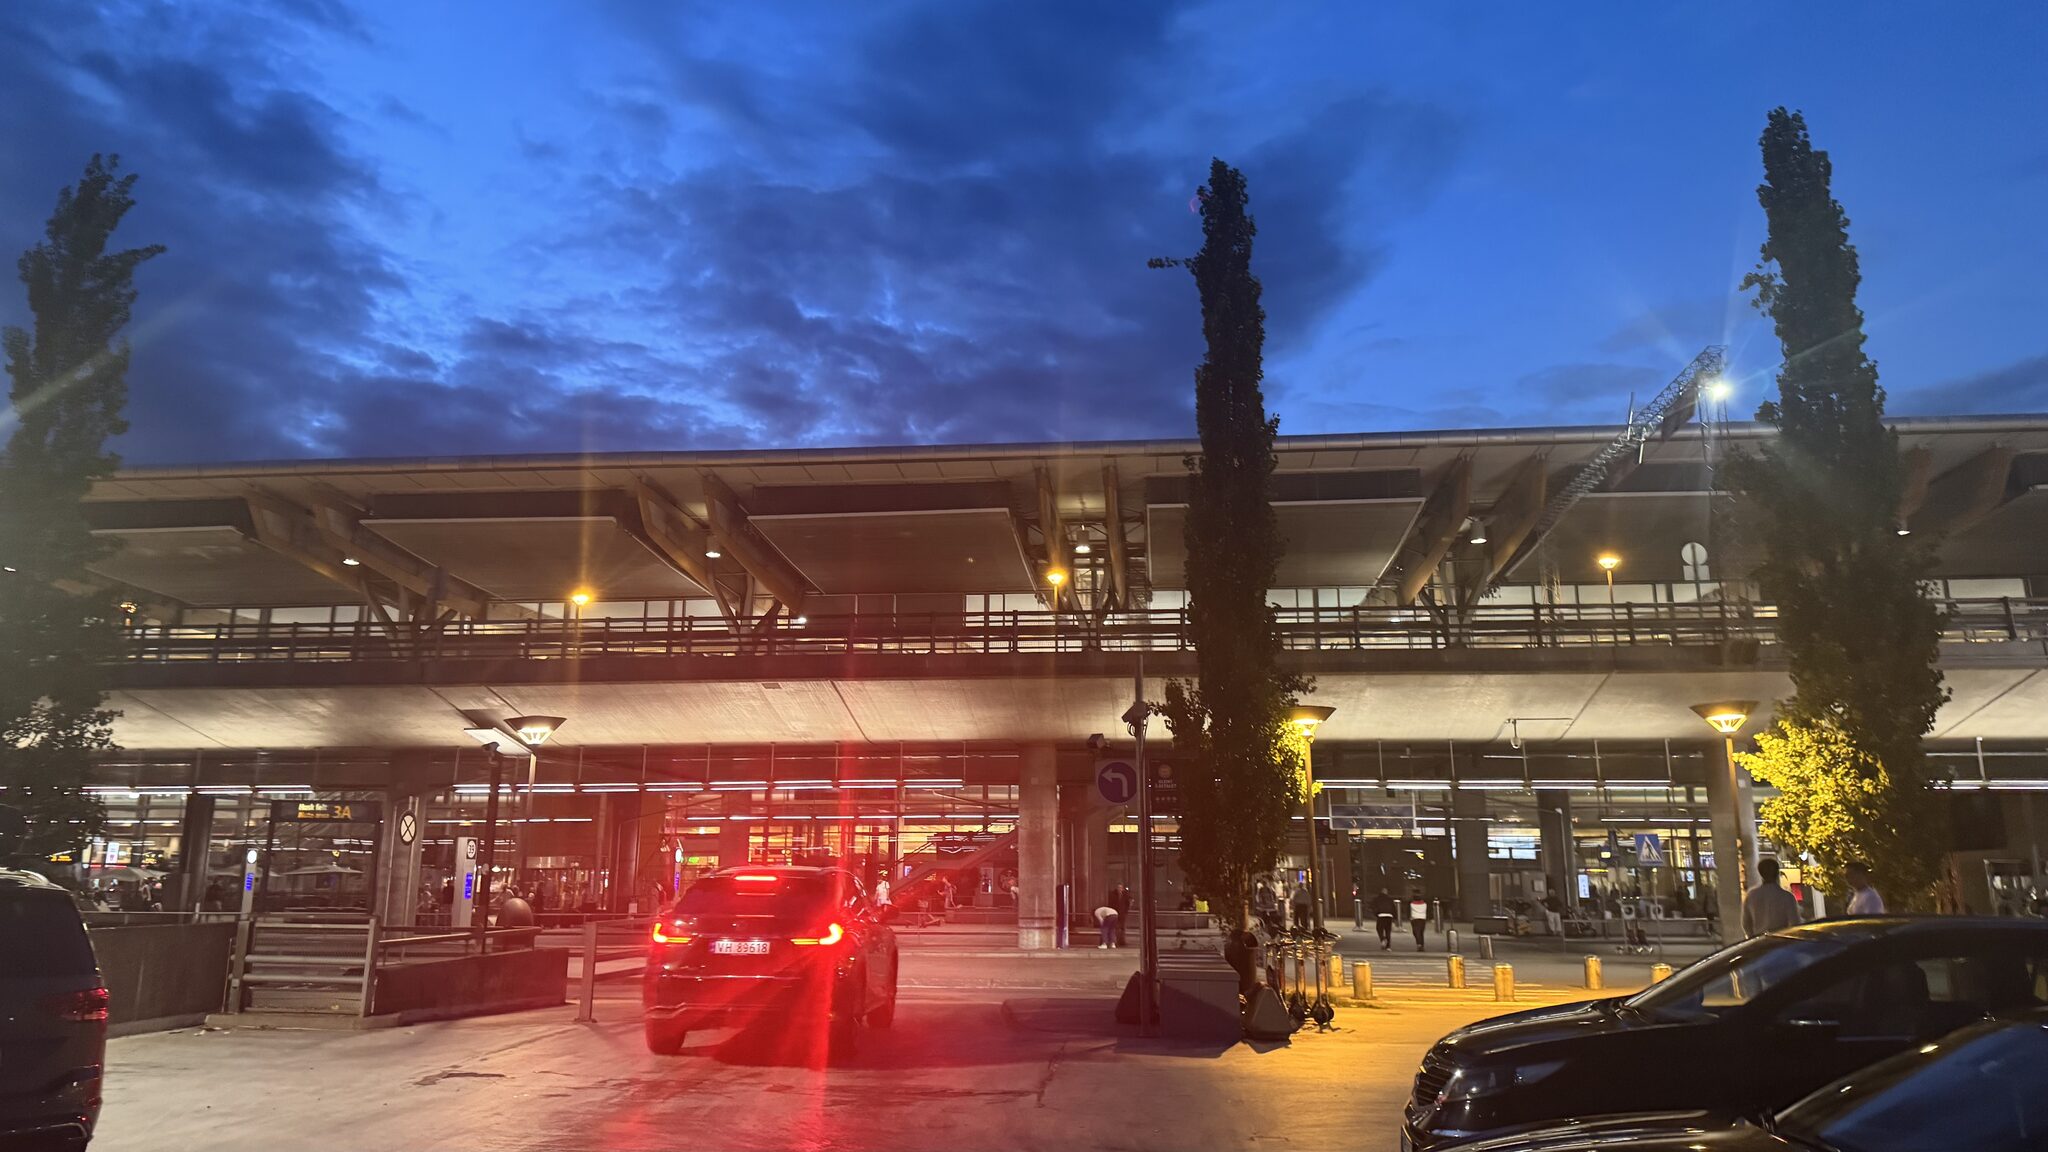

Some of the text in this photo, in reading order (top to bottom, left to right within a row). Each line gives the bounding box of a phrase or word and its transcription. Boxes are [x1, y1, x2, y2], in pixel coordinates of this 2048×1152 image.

[332, 805, 352, 820] 3A
[717, 942, 768, 953] VH 89618
